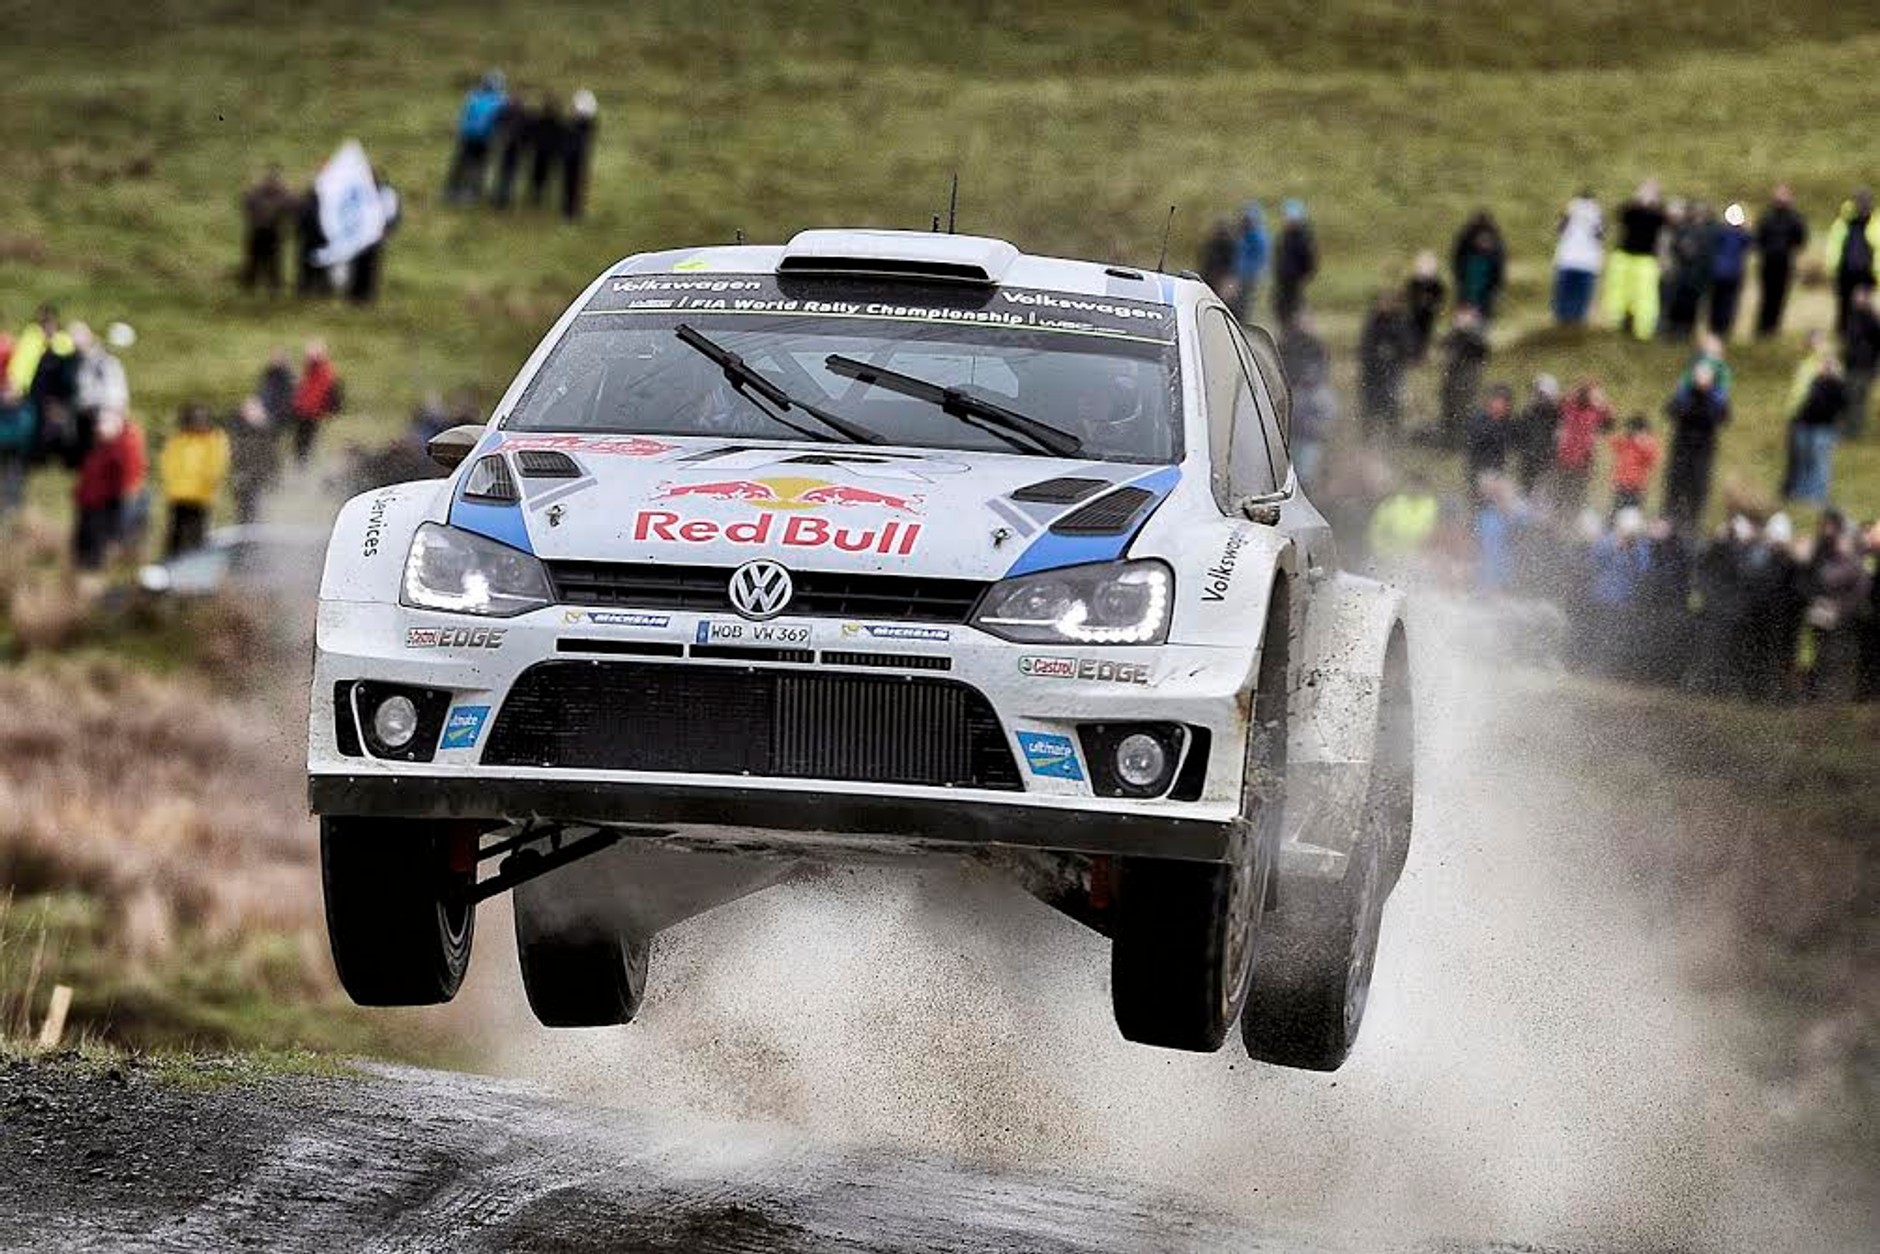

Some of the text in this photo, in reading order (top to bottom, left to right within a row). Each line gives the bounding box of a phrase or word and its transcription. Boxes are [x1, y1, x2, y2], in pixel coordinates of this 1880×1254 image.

[612, 280, 761, 293] Volkswagen
[690, 299, 725, 309] FIA
[734, 299, 797, 311] World
[803, 301, 860, 314] Rally
[866, 304, 1023, 324] Championship
[1002, 291, 1163, 319] Volkswagen
[634, 511, 921, 555] Red Bull
[438, 627, 508, 648] EDGE
[711, 624, 809, 642] WOB VW 369
[873, 626, 948, 639] MICHELIN
[1033, 658, 1150, 684] Castrol EDGE
